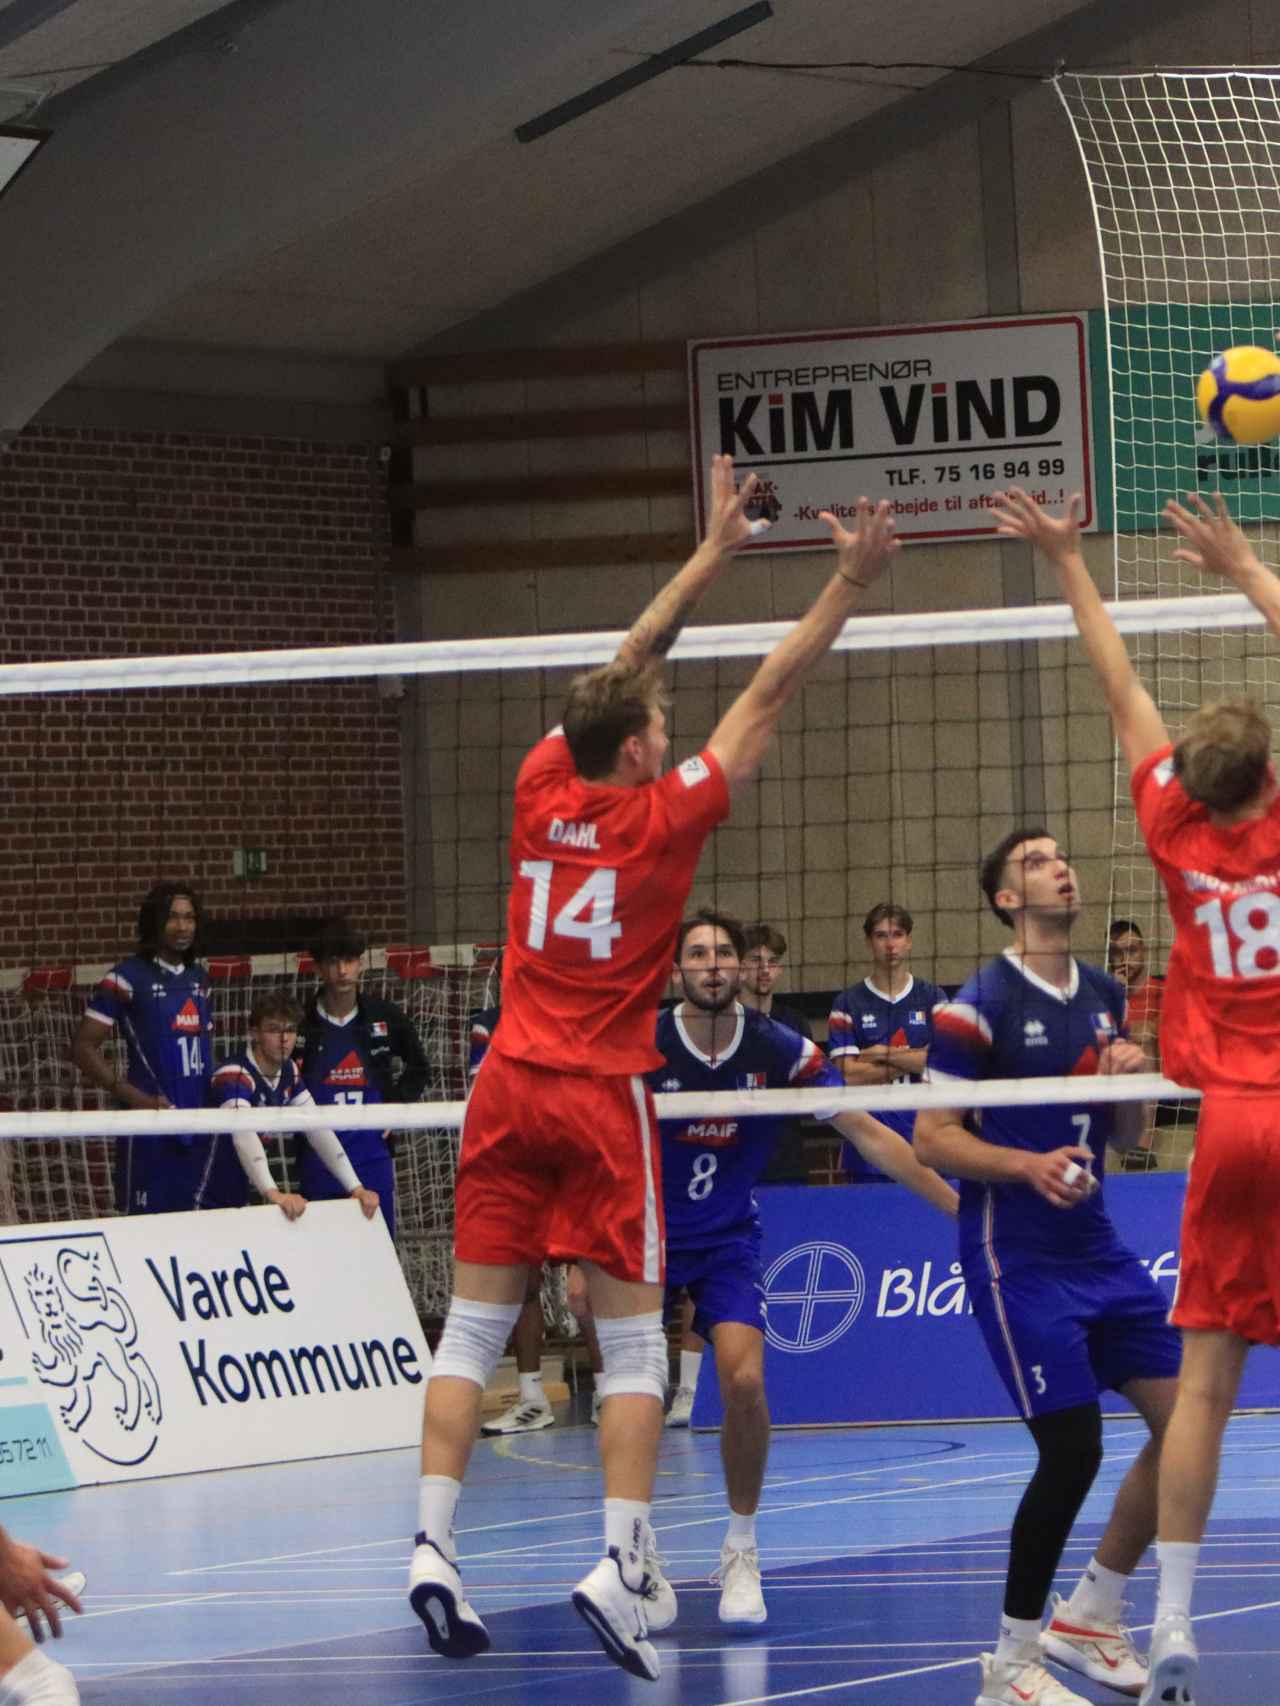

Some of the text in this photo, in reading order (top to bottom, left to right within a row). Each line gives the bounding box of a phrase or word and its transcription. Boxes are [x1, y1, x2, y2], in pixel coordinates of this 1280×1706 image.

[718, 359, 932, 392] ENTREPRENØR
[885, 458, 1065, 486] TLF. 75 16 94 99
[944, 496, 962, 511] til
[548, 817, 600, 850] DAHL
[520, 860, 622, 960] 14
[177, 1036, 204, 1077] 14
[688, 1152, 718, 1201] 8
[145, 1249, 296, 1323] Varde
[180, 1335, 424, 1407] Kommune
[1031, 1365, 1047, 1394] 3
